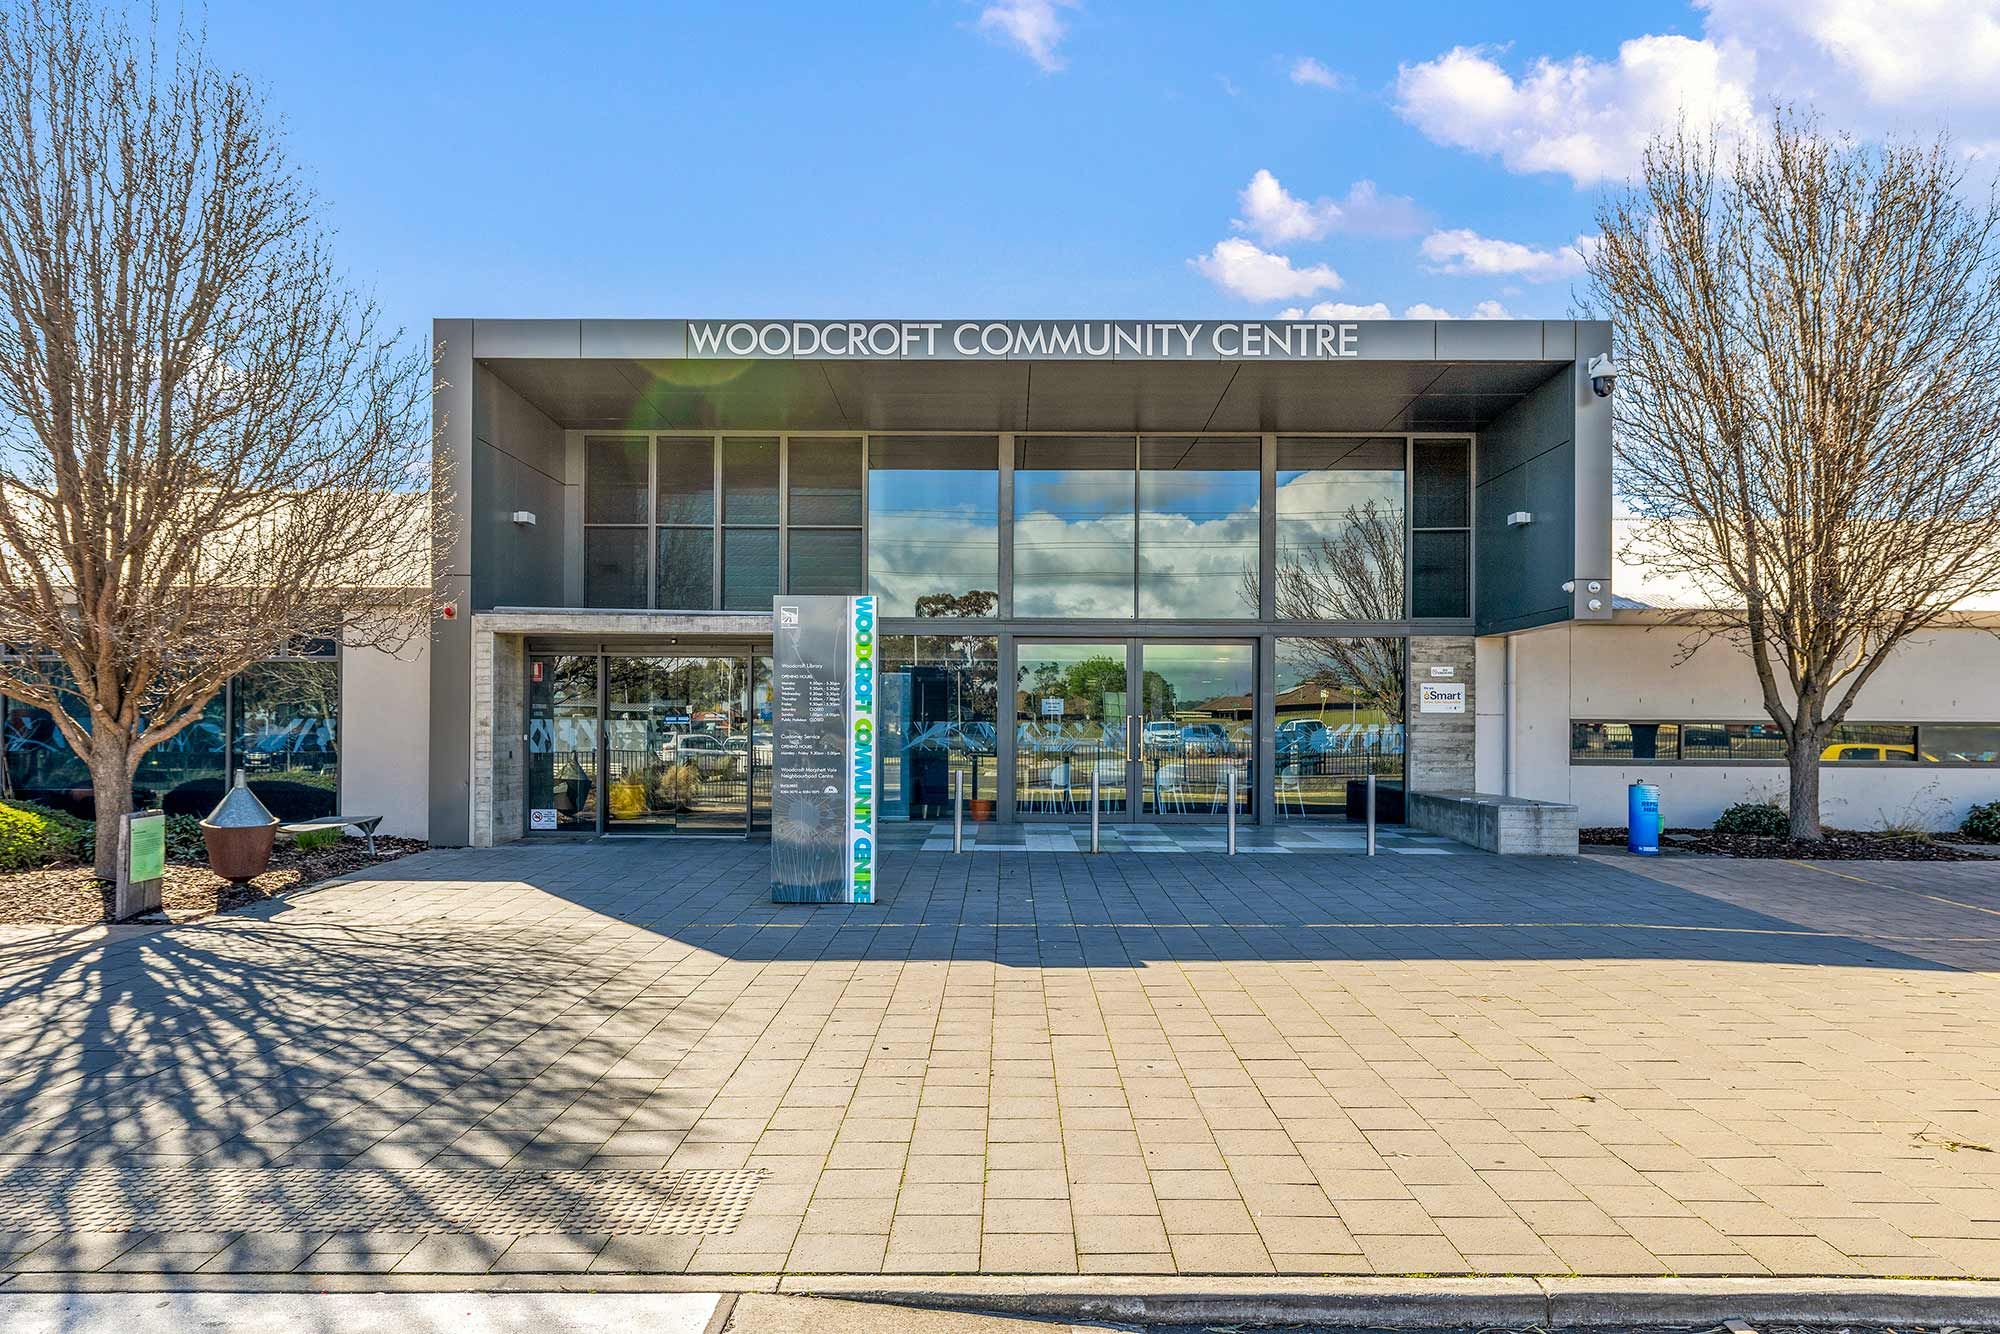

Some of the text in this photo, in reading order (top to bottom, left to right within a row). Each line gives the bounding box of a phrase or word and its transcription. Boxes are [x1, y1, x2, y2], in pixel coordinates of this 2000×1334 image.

[688, 323, 1358, 357] WOODCROFT COMMUNITY CENTRE
[853, 596, 873, 903] WOODCROFT COMMUNITY CENTRE
